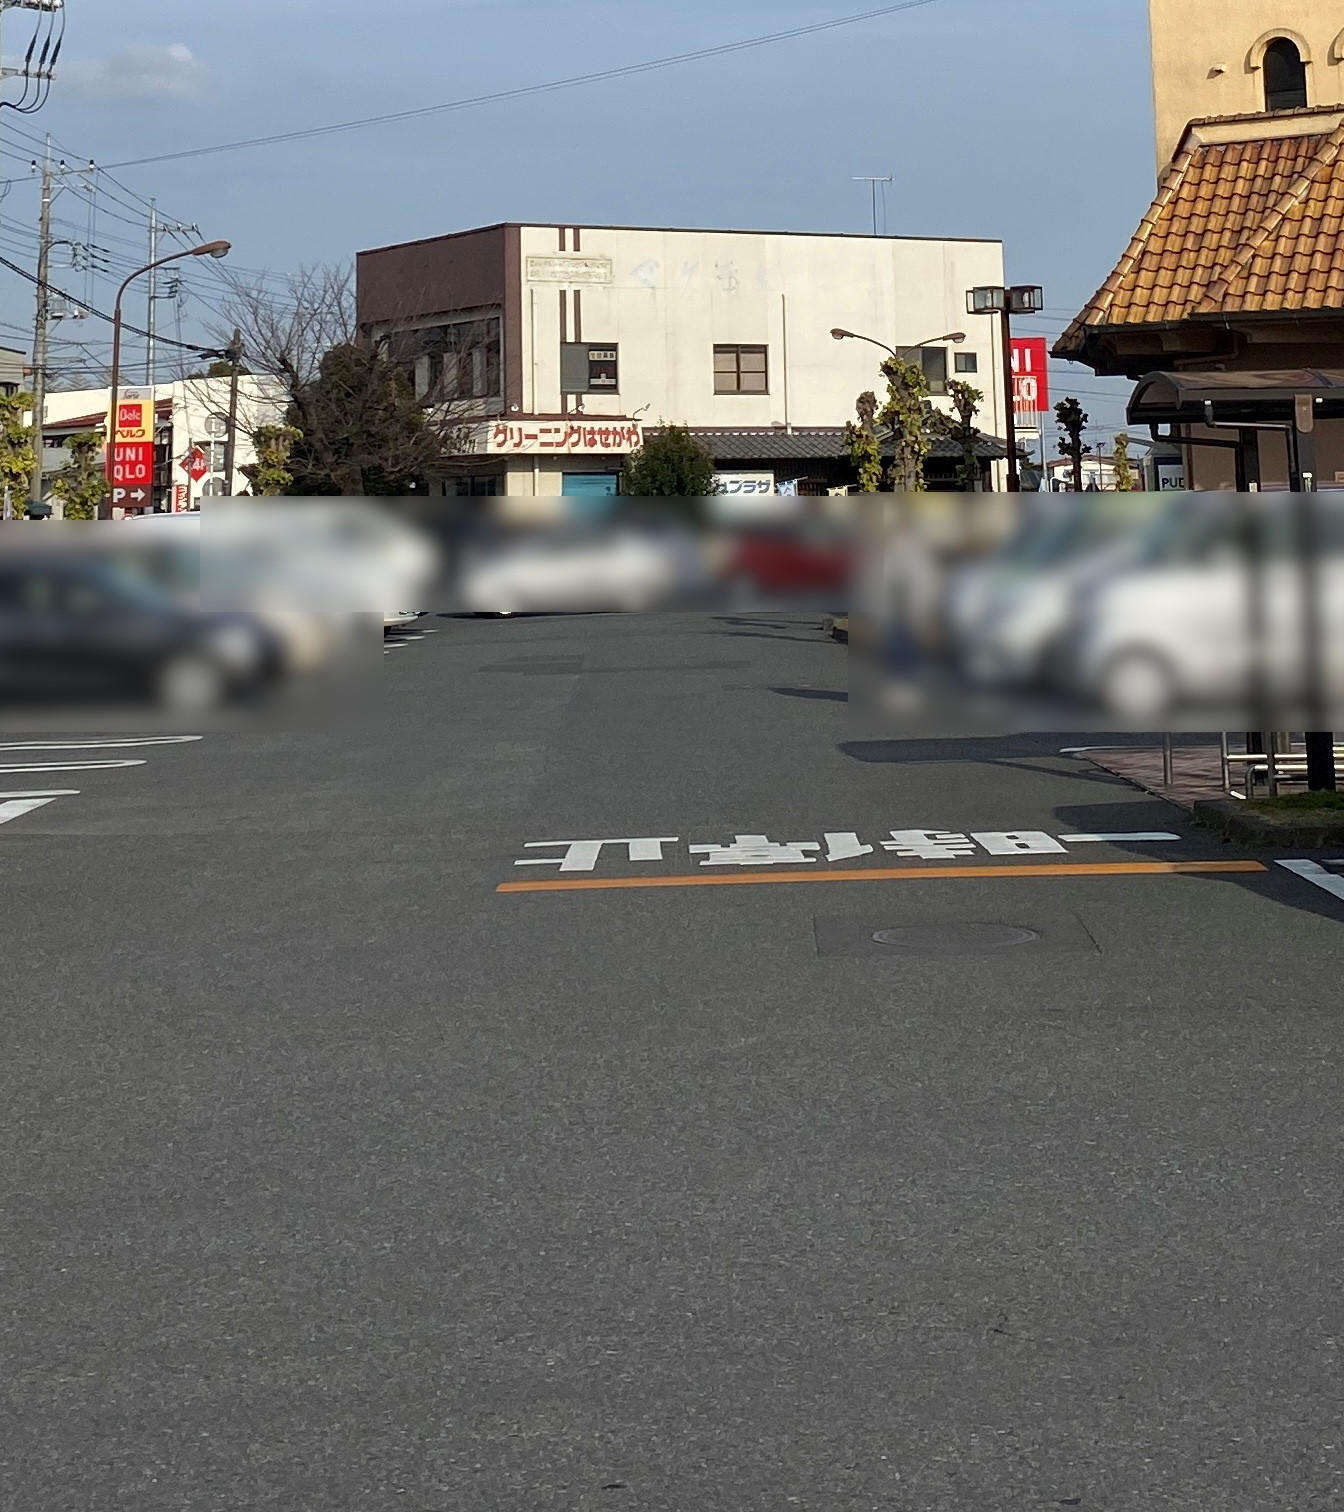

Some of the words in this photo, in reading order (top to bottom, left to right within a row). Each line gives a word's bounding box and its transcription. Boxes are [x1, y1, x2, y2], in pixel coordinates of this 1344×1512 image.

[114, 429, 146, 438] ベルク
[114, 446, 144, 462] UNI
[113, 464, 146, 482] QLO
[112, 487, 126, 503] P
[513, 828, 1183, 872] 一時停止
